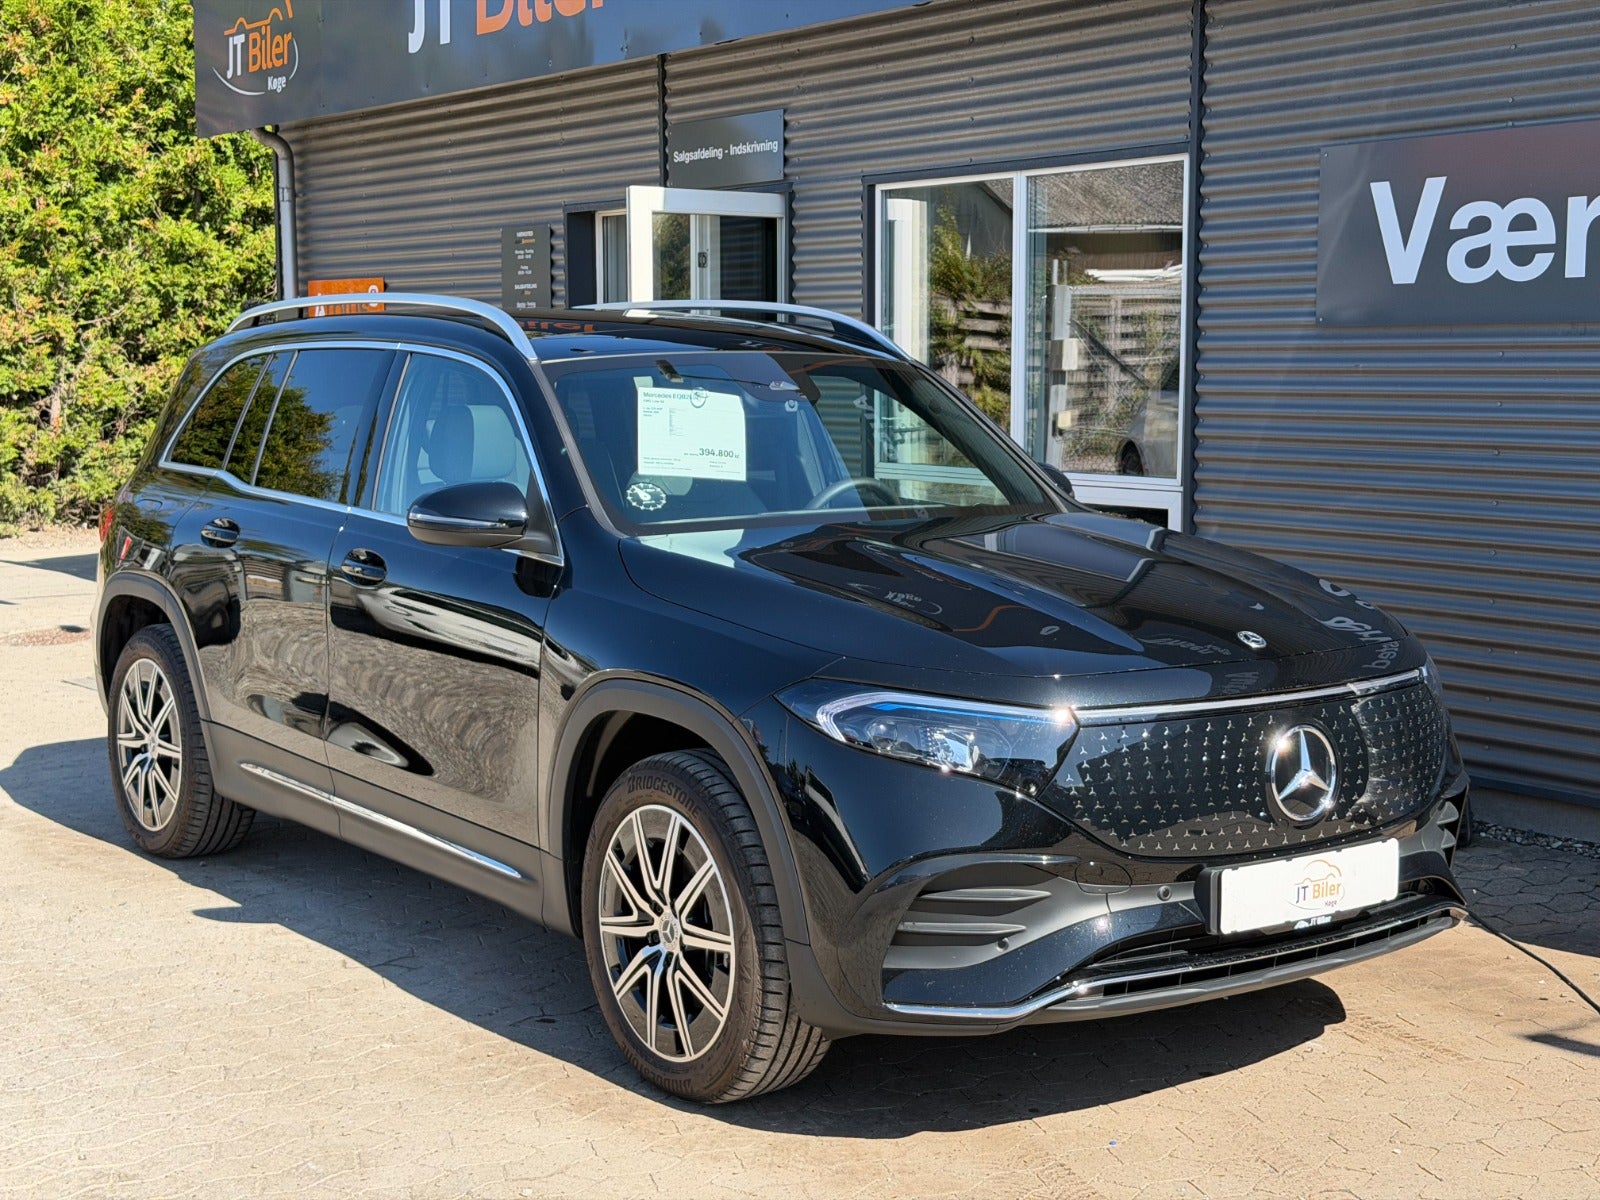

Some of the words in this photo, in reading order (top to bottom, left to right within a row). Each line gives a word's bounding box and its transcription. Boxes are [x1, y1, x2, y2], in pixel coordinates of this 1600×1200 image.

[226, 33, 246, 79] JT
[248, 25, 293, 73] Biler
[673, 146, 722, 163] Salgsafdeling
[730, 139, 778, 155] Indskrivning
[1369, 175, 1600, 285] Vær
[698, 447, 734, 459] 394.800
[627, 774, 702, 819] BRIDGESTONE
[1296, 885, 1309, 905] JT
[1312, 881, 1342, 899] Biler
